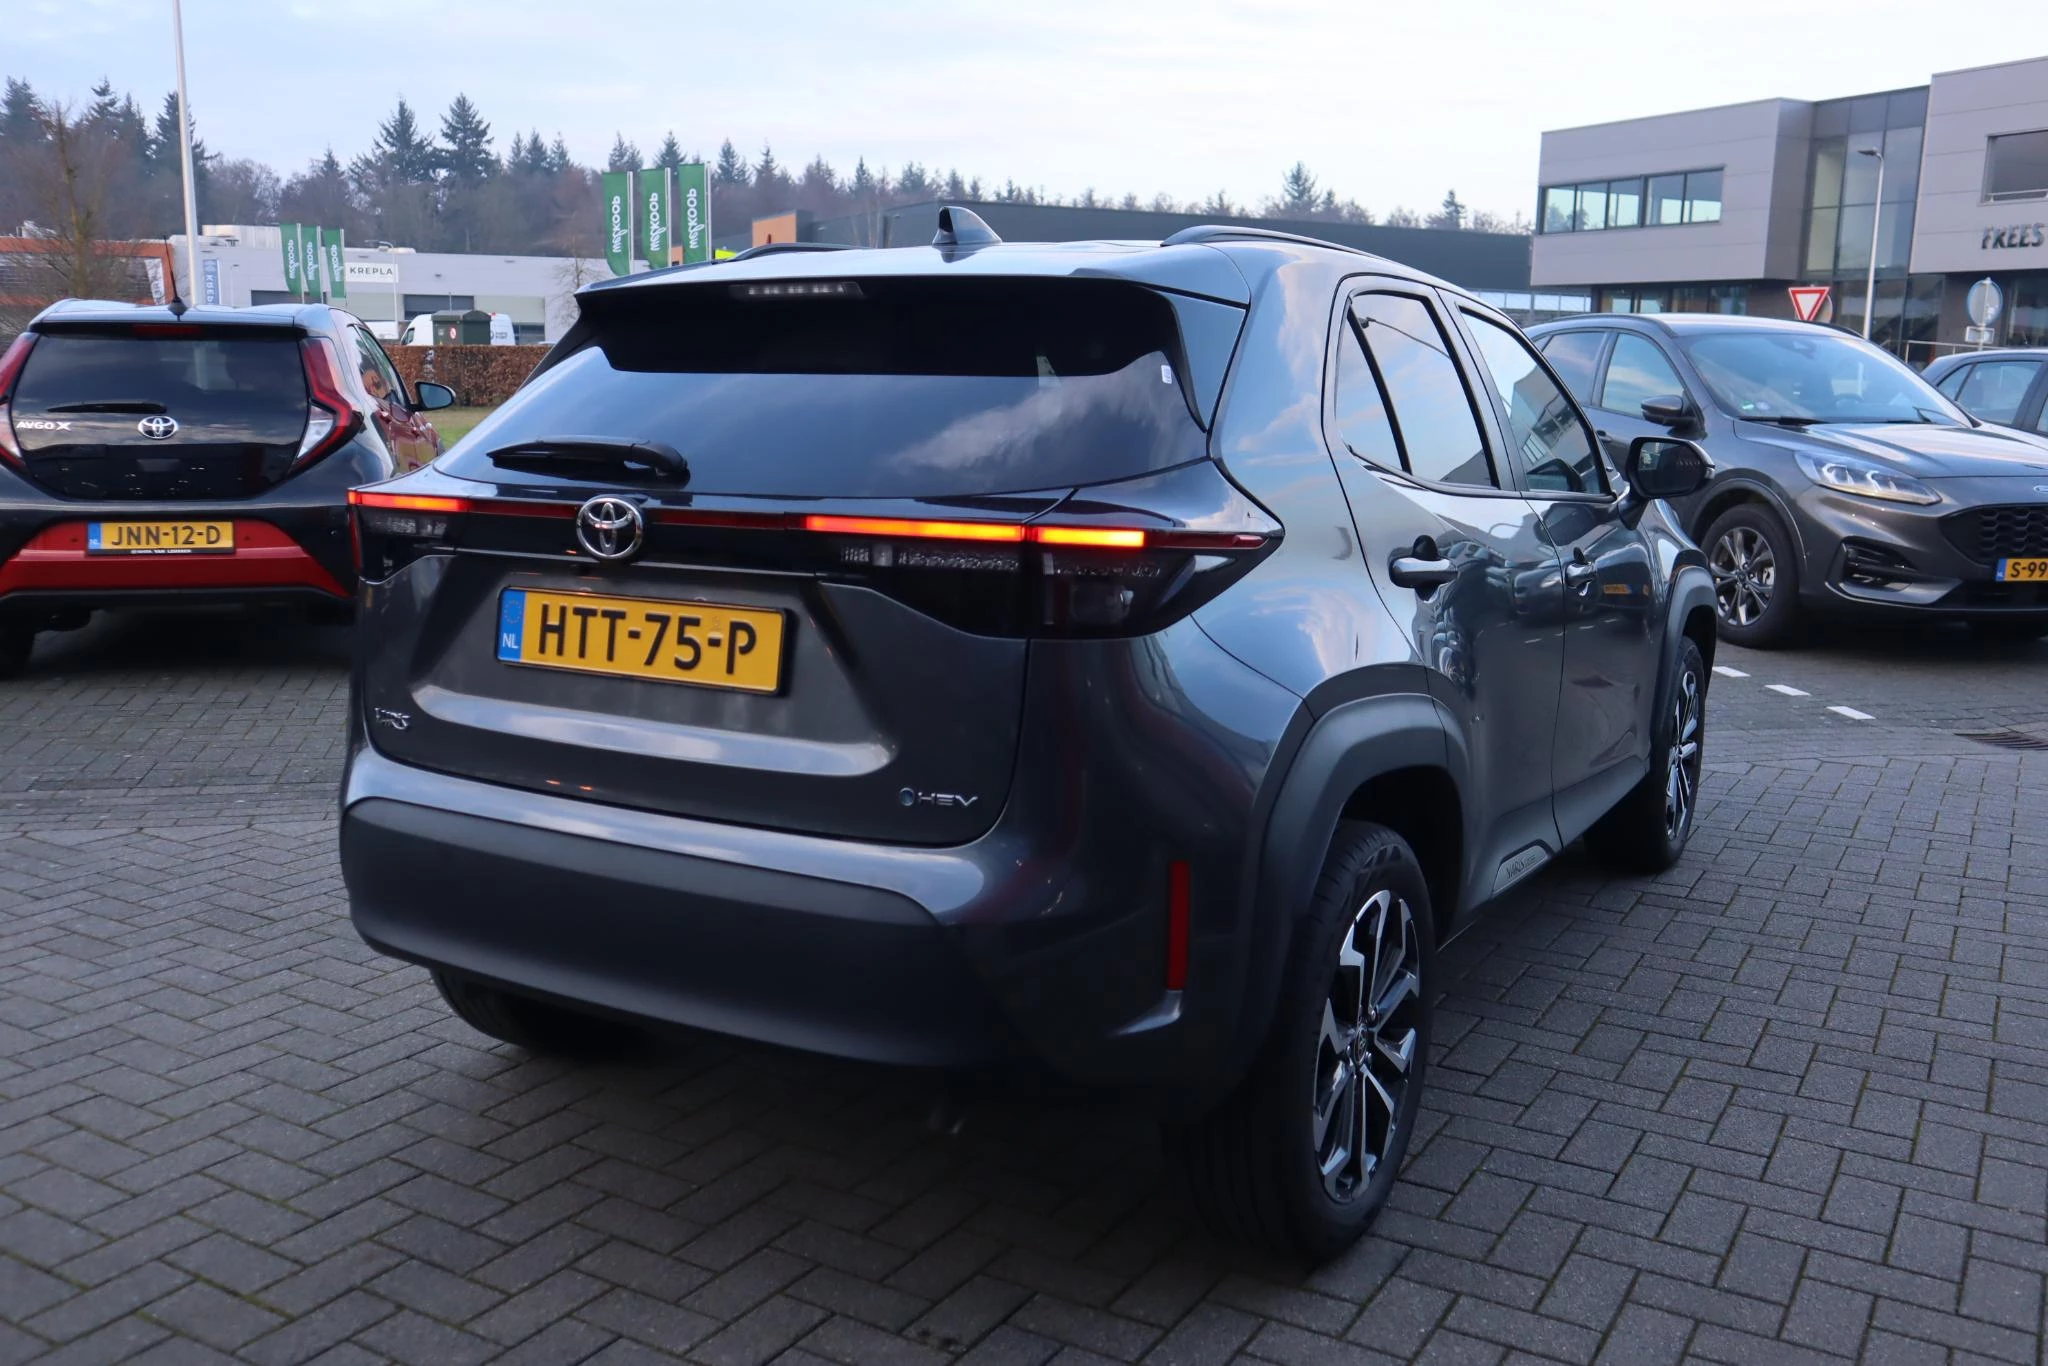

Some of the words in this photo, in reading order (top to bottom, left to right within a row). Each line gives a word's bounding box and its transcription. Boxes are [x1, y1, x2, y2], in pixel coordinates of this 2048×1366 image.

[1981, 222, 2045, 249] FREES
[349, 266, 393, 275] KREPLA
[111, 525, 221, 546] JNN-12-D
[502, 632, 519, 649] NL
[538, 603, 757, 675] HTT-75-P
